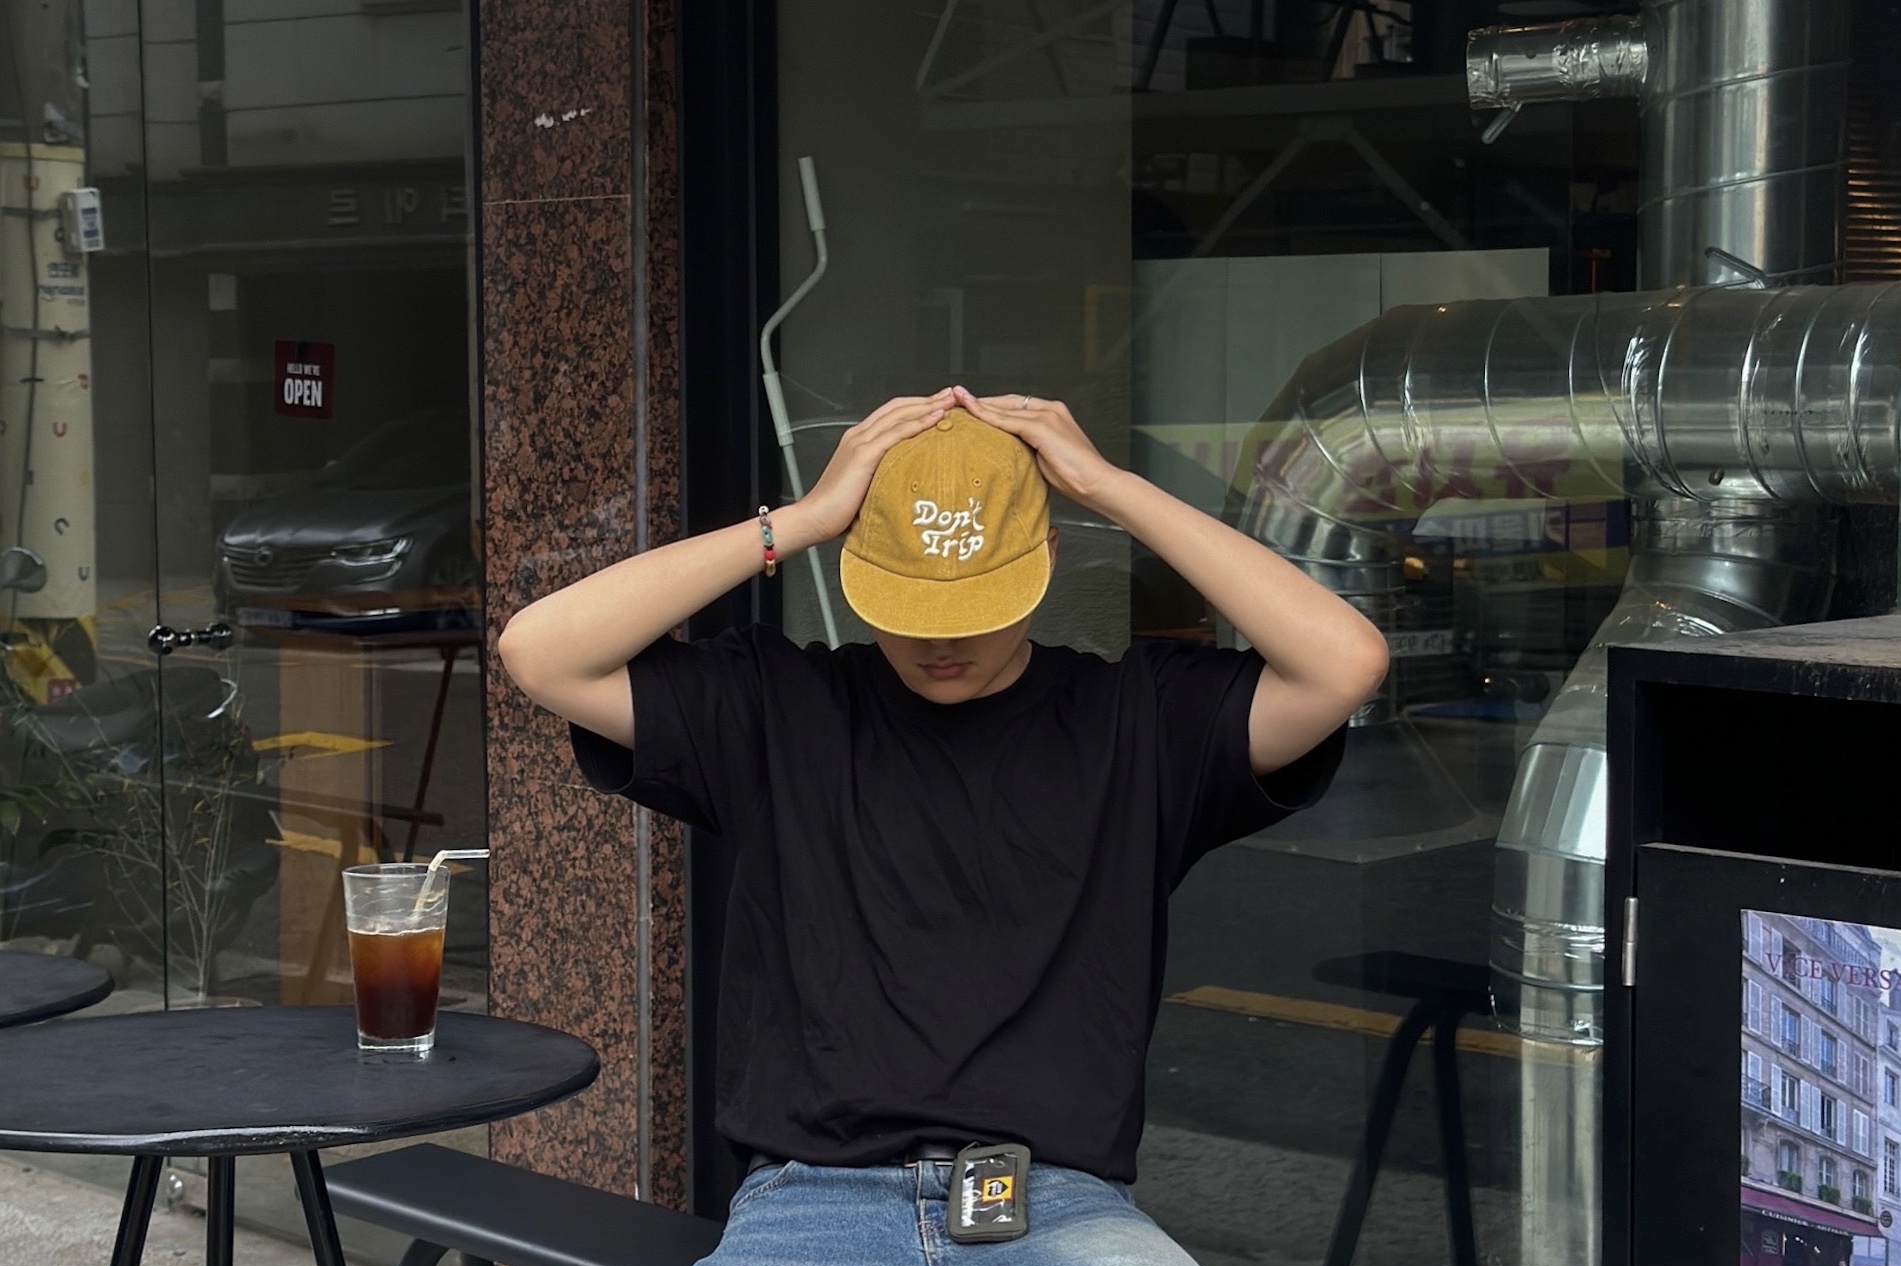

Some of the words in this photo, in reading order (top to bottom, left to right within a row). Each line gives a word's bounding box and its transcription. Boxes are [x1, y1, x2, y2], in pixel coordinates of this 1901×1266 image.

[283, 378, 323, 408] OPEN
[912, 497, 985, 532] Don't
[921, 528, 985, 561] Trip
